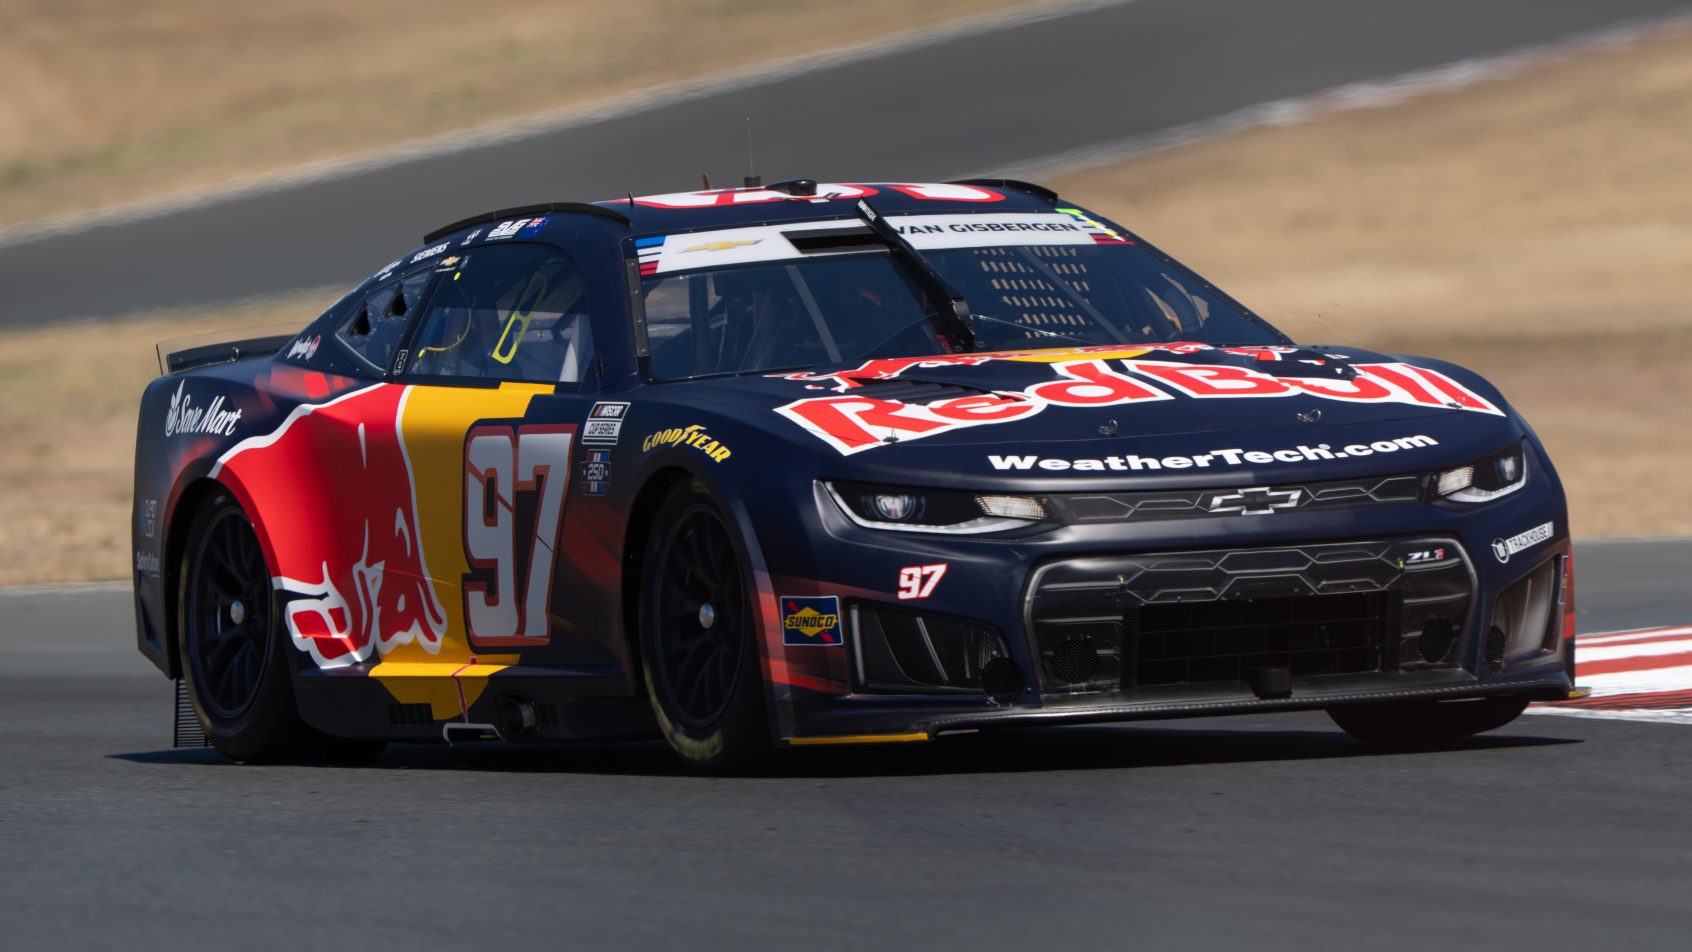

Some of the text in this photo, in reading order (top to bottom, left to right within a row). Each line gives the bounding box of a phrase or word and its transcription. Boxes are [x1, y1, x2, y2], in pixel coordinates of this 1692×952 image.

[949, 222, 1080, 233] GISBERGEN
[176, 394, 242, 437] Save Mart
[597, 405, 624, 417] NASCAR
[773, 357, 1507, 456] Red Bull
[588, 422, 617, 434] CUP SERIES
[643, 424, 731, 463] GOODYEAR
[587, 463, 605, 481] 250
[464, 423, 579, 647] 97
[1508, 525, 1549, 553] TRACKHOUSE
[1406, 548, 1445, 564] ZL1
[898, 563, 948, 600] 97
[787, 615, 834, 628] SUNOCO
